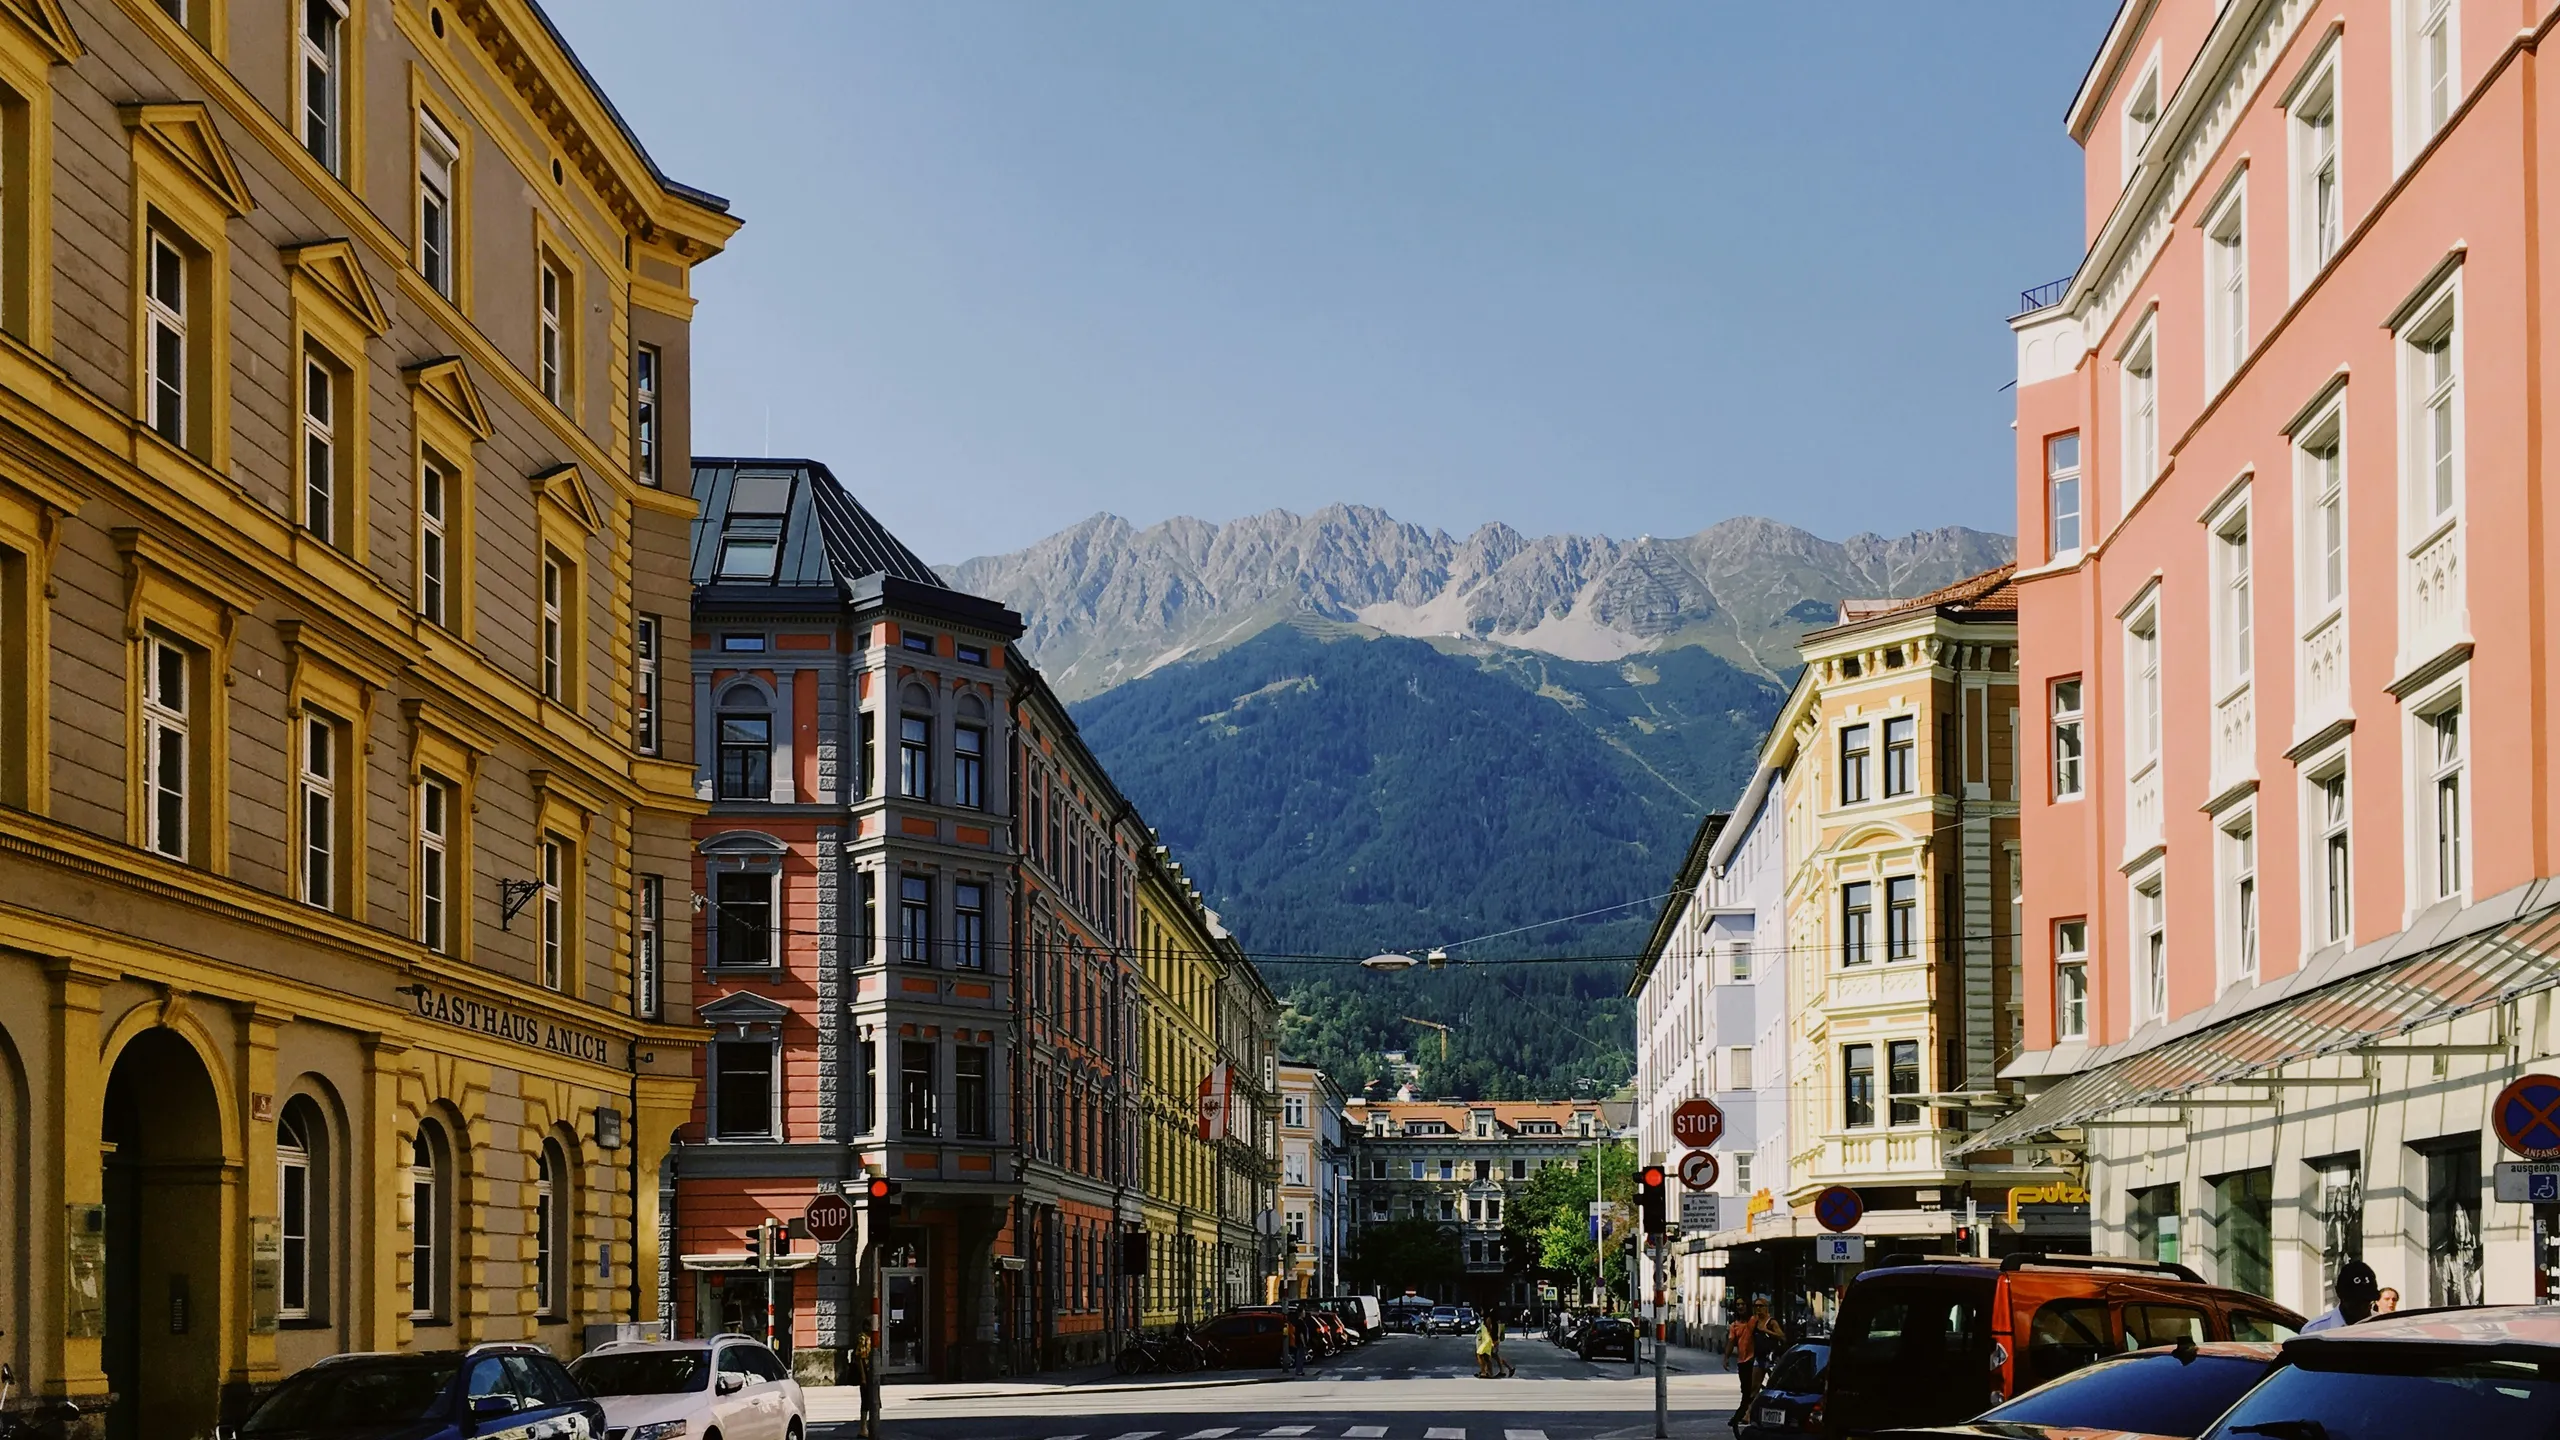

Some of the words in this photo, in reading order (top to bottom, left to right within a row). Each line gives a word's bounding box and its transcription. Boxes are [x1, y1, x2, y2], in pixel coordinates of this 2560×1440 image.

[417, 987, 538, 1045] GASTHAUS
[545, 1025, 607, 1063] ANICH
[1677, 1114, 1718, 1133] STOP
[2523, 1147, 2559, 1158] ANFANG
[810, 1208, 847, 1227] STOP
